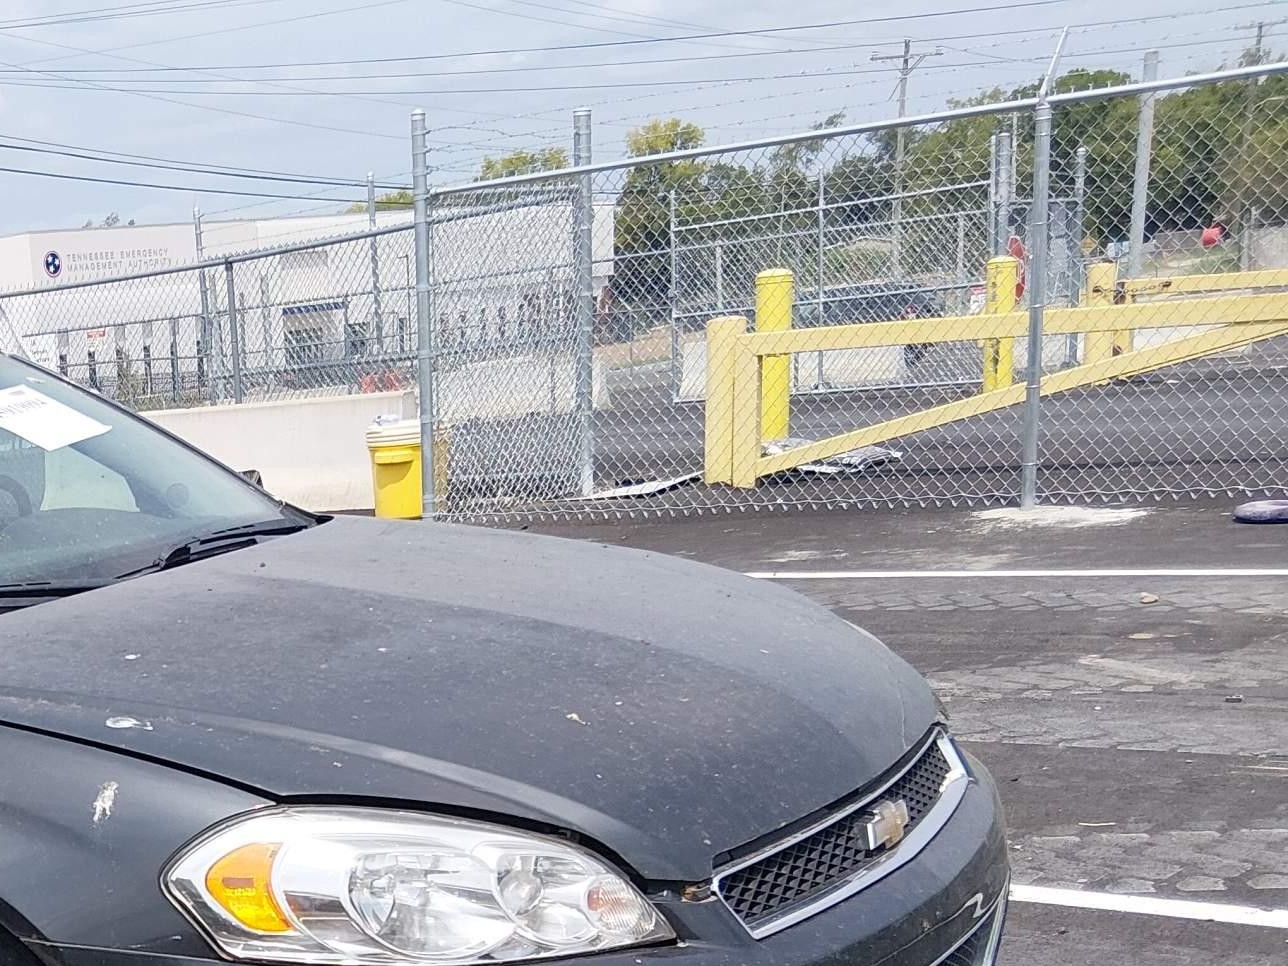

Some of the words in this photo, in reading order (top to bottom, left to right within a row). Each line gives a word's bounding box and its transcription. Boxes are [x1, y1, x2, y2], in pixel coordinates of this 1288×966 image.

[66, 251, 115, 262] TENNESSEE
[119, 248, 169, 259] EMERGENCY
[67, 260, 122, 272] MANAGEMENT
